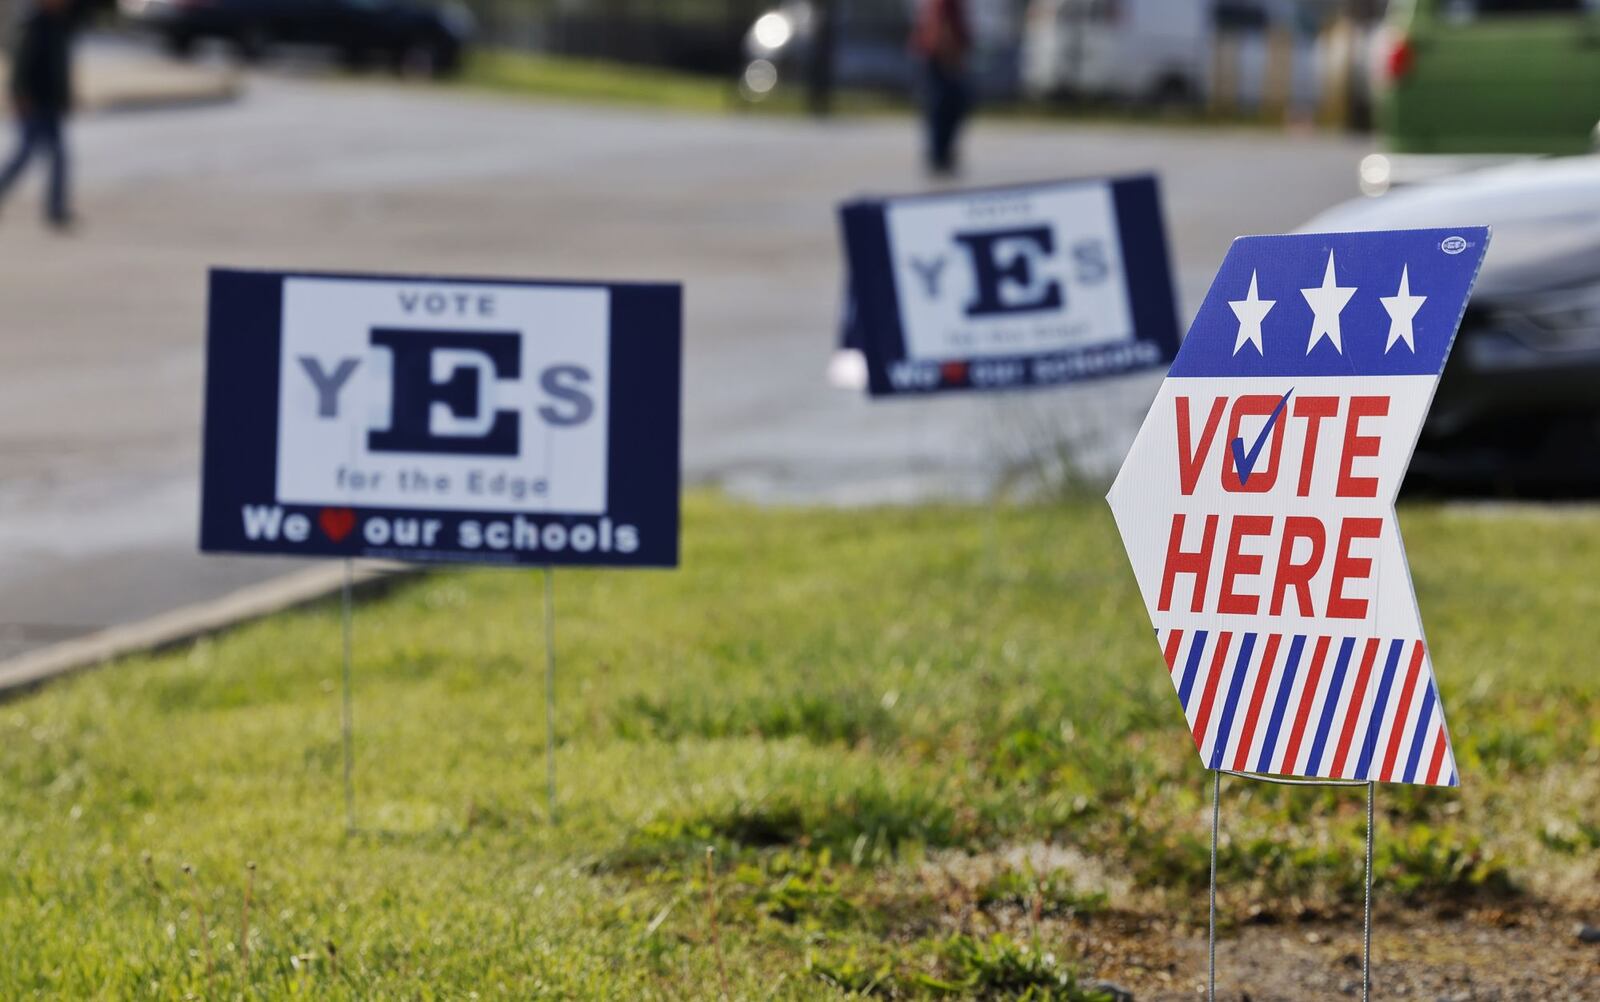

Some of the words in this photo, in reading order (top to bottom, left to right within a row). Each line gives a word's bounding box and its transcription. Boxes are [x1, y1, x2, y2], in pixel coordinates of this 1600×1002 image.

[399, 291, 497, 316] VOTE
[910, 224, 1108, 317] YES
[297, 326, 595, 458] YES
[336, 467, 383, 492] for
[399, 469, 451, 495] the
[467, 471, 550, 500] Edge
[1174, 394, 1391, 498] VOTE
[242, 504, 311, 541] We
[363, 516, 443, 547] our
[458, 516, 641, 553] schools
[1157, 513, 1383, 620] HERE
